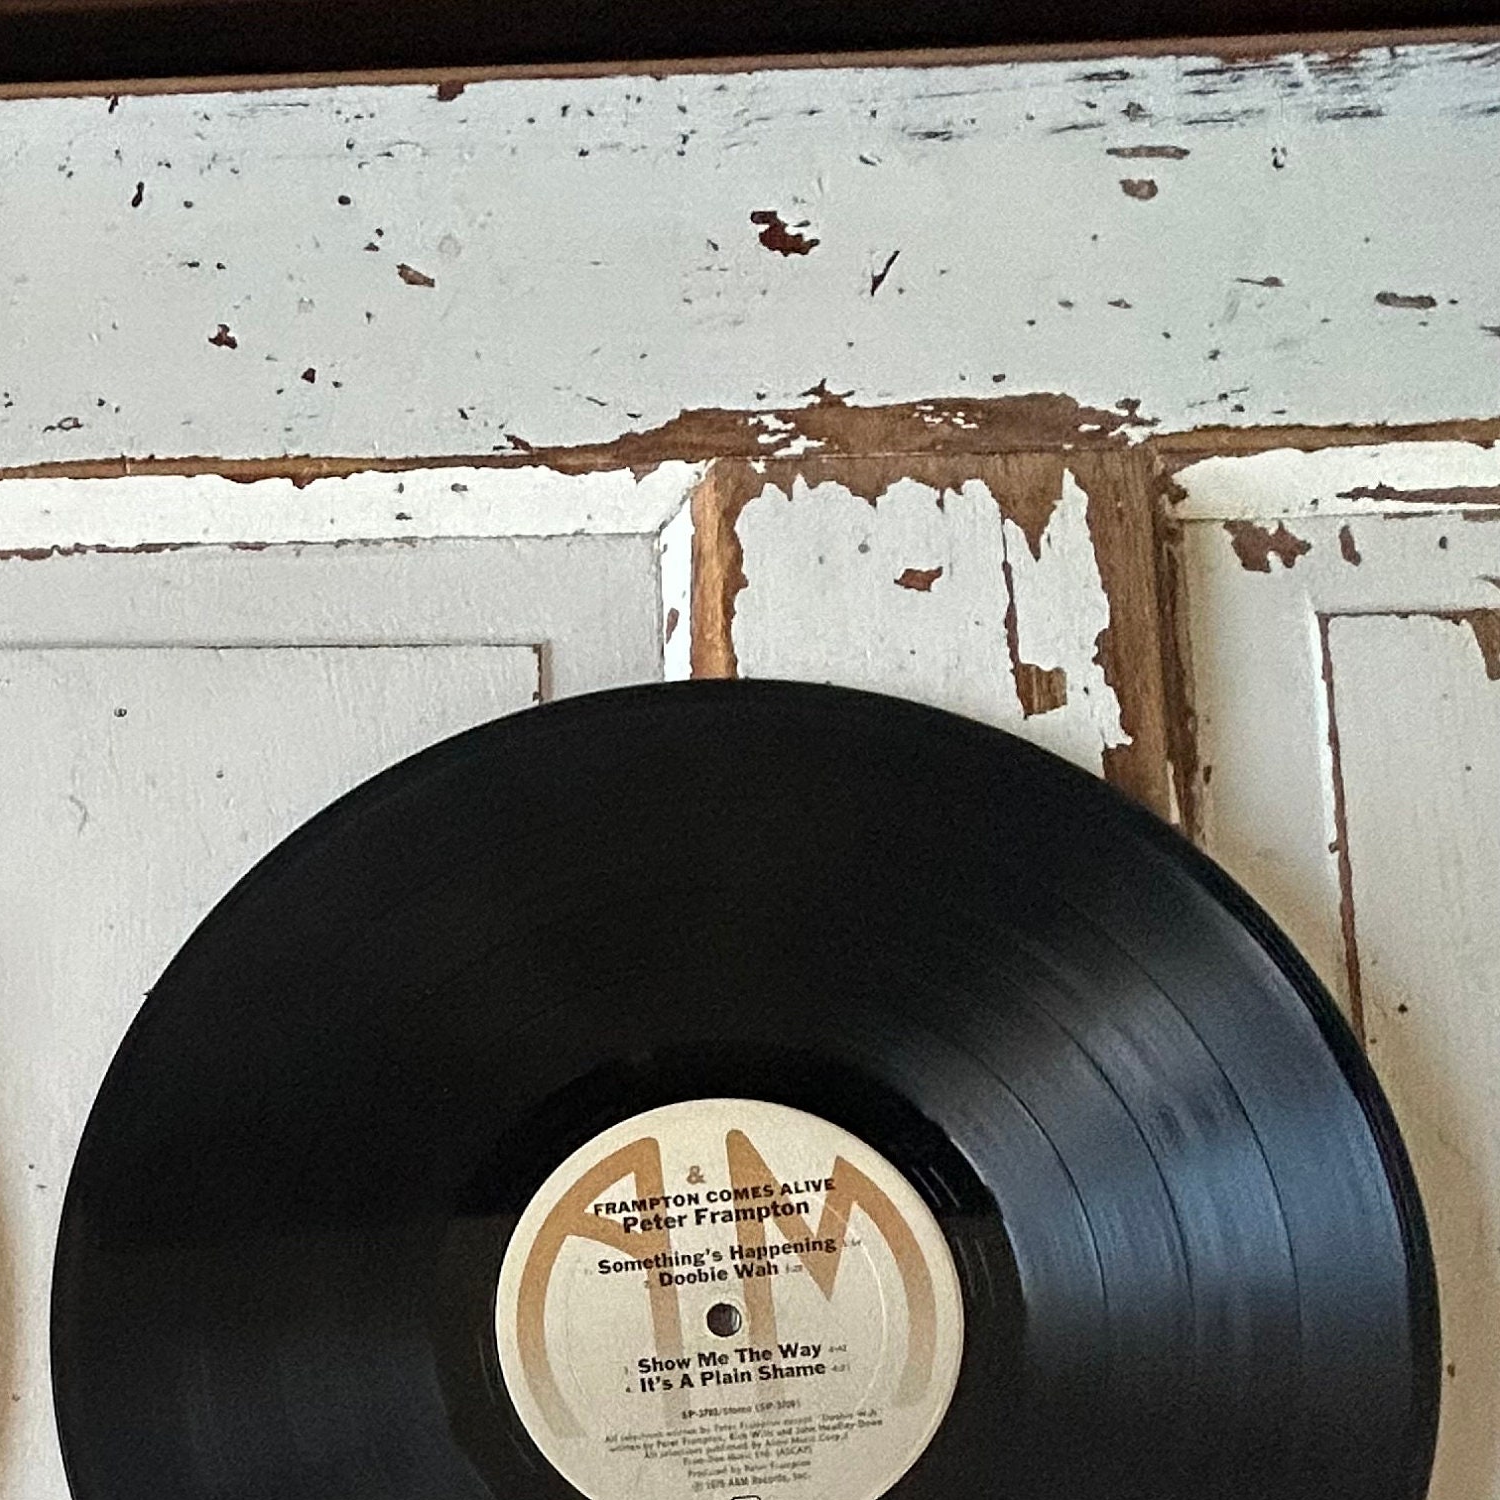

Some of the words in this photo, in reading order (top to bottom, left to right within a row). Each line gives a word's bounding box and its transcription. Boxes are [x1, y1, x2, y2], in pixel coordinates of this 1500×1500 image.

[686, 1165, 706, 1185] &
[594, 1192, 700, 1216] FRAMPTON
[706, 1184, 774, 1203] COMES
[780, 1178, 836, 1196] ALIVE
[623, 1213, 688, 1234] Peter
[694, 1200, 810, 1226] Frampton
[598, 1247, 723, 1275] Something's
[729, 1237, 837, 1260] Happening
[659, 1266, 729, 1287] Doobie
[733, 1260, 779, 1280] Wah
[638, 1357, 691, 1374] Show
[697, 1352, 729, 1369] Me
[733, 1348, 773, 1364] The
[778, 1342, 822, 1359] Way
[639, 1376, 674, 1393] It's
[680, 1373, 694, 1389] A
[700, 1367, 753, 1387] Plain
[758, 1361, 826, 1381] Shame
